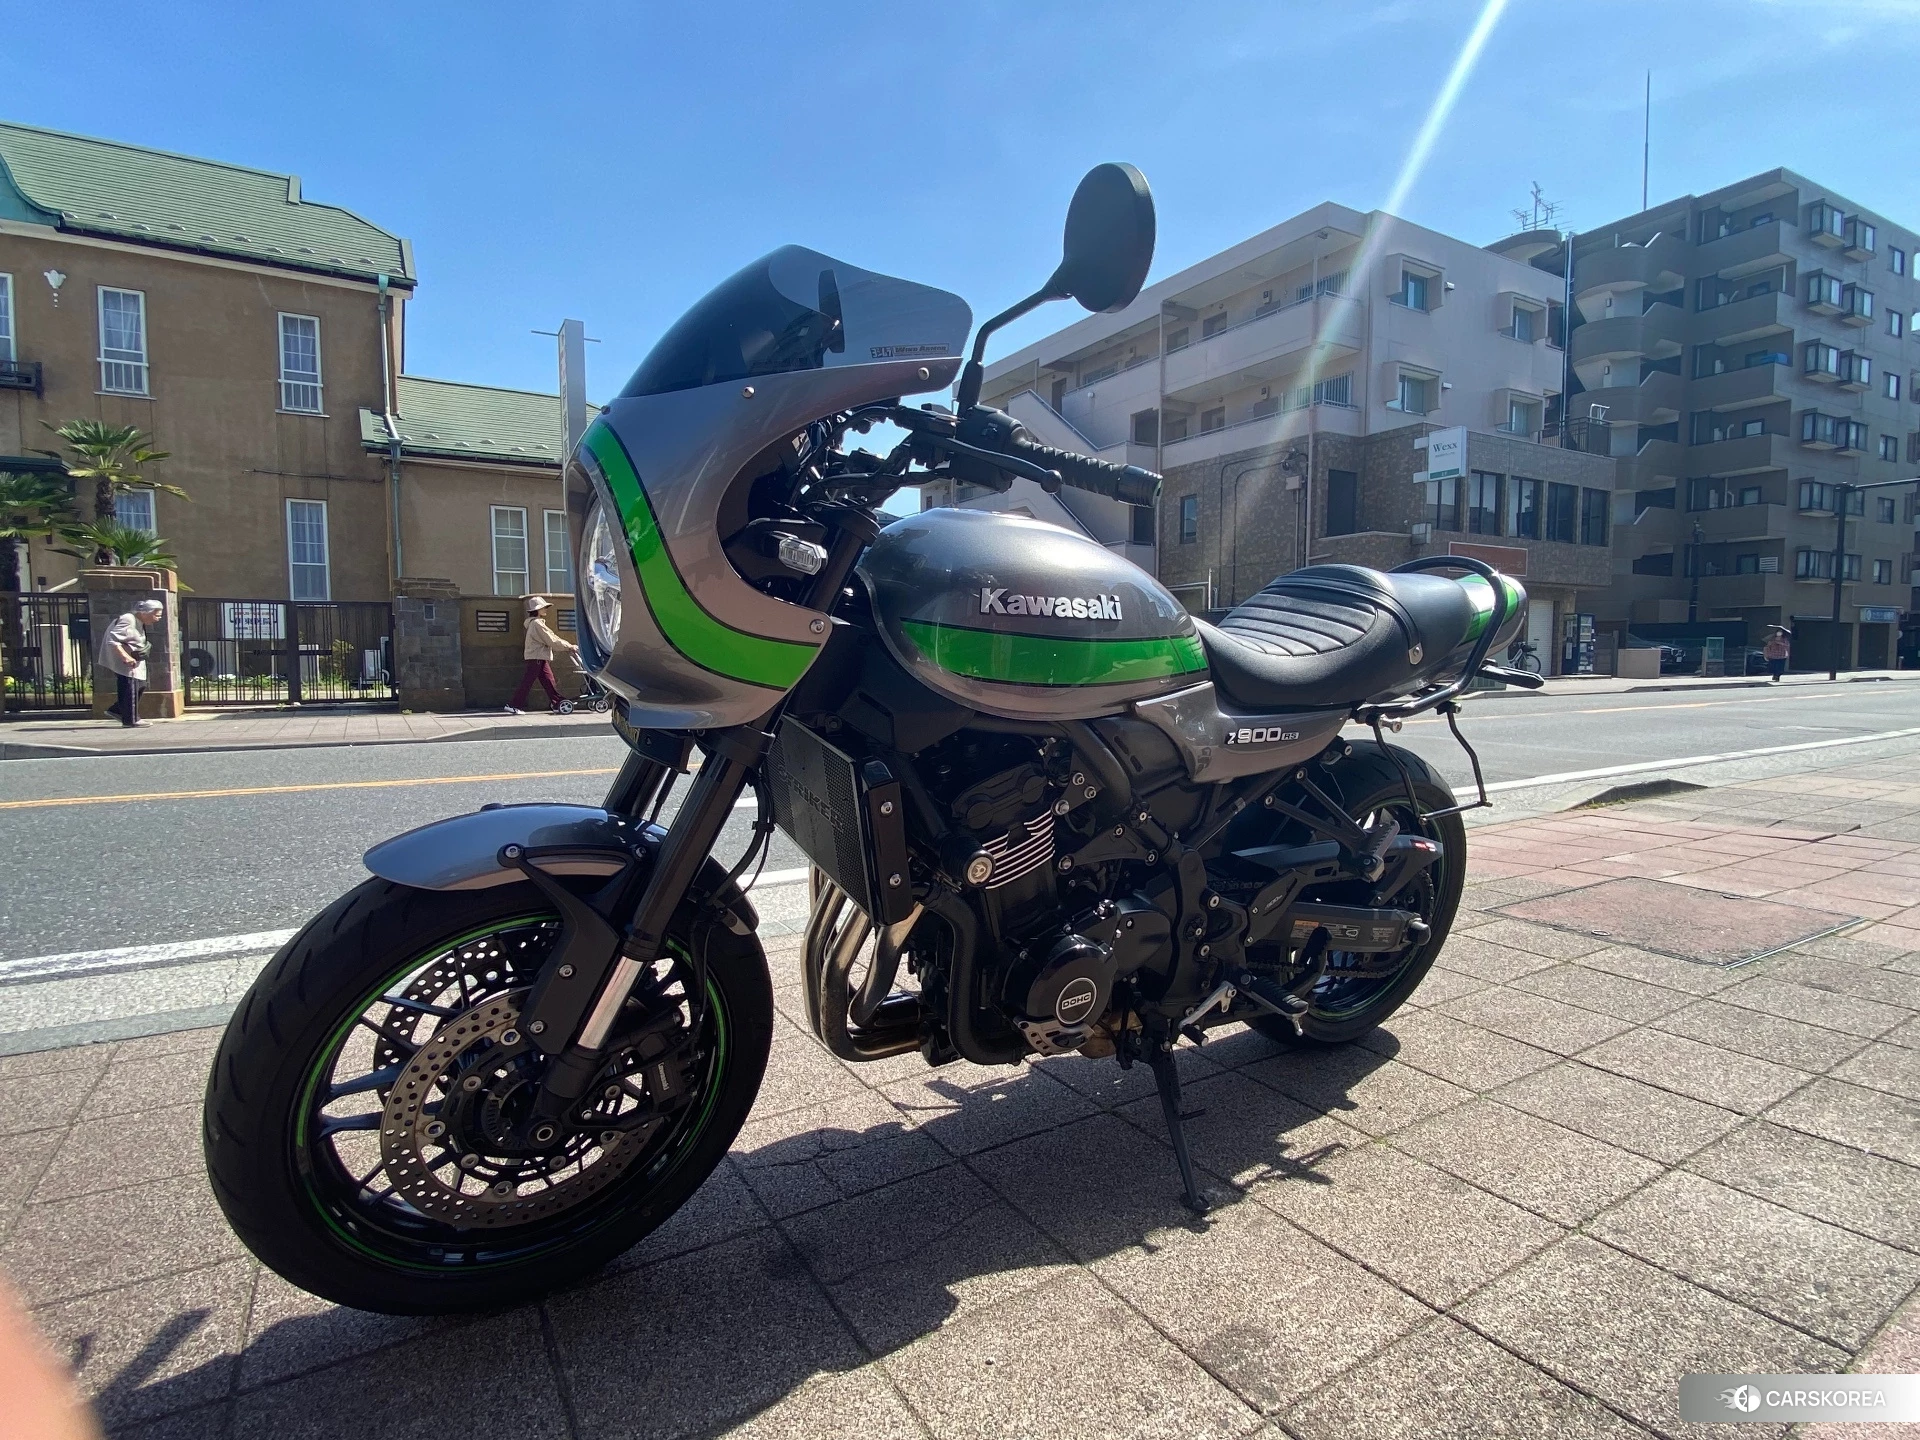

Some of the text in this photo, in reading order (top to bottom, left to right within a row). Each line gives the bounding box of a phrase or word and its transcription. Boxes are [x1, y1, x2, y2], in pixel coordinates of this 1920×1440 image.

[1433, 442, 1458, 452] Wexx
[980, 587, 1122, 620] Kawasaki
[1062, 994, 1091, 1008] DOHC
